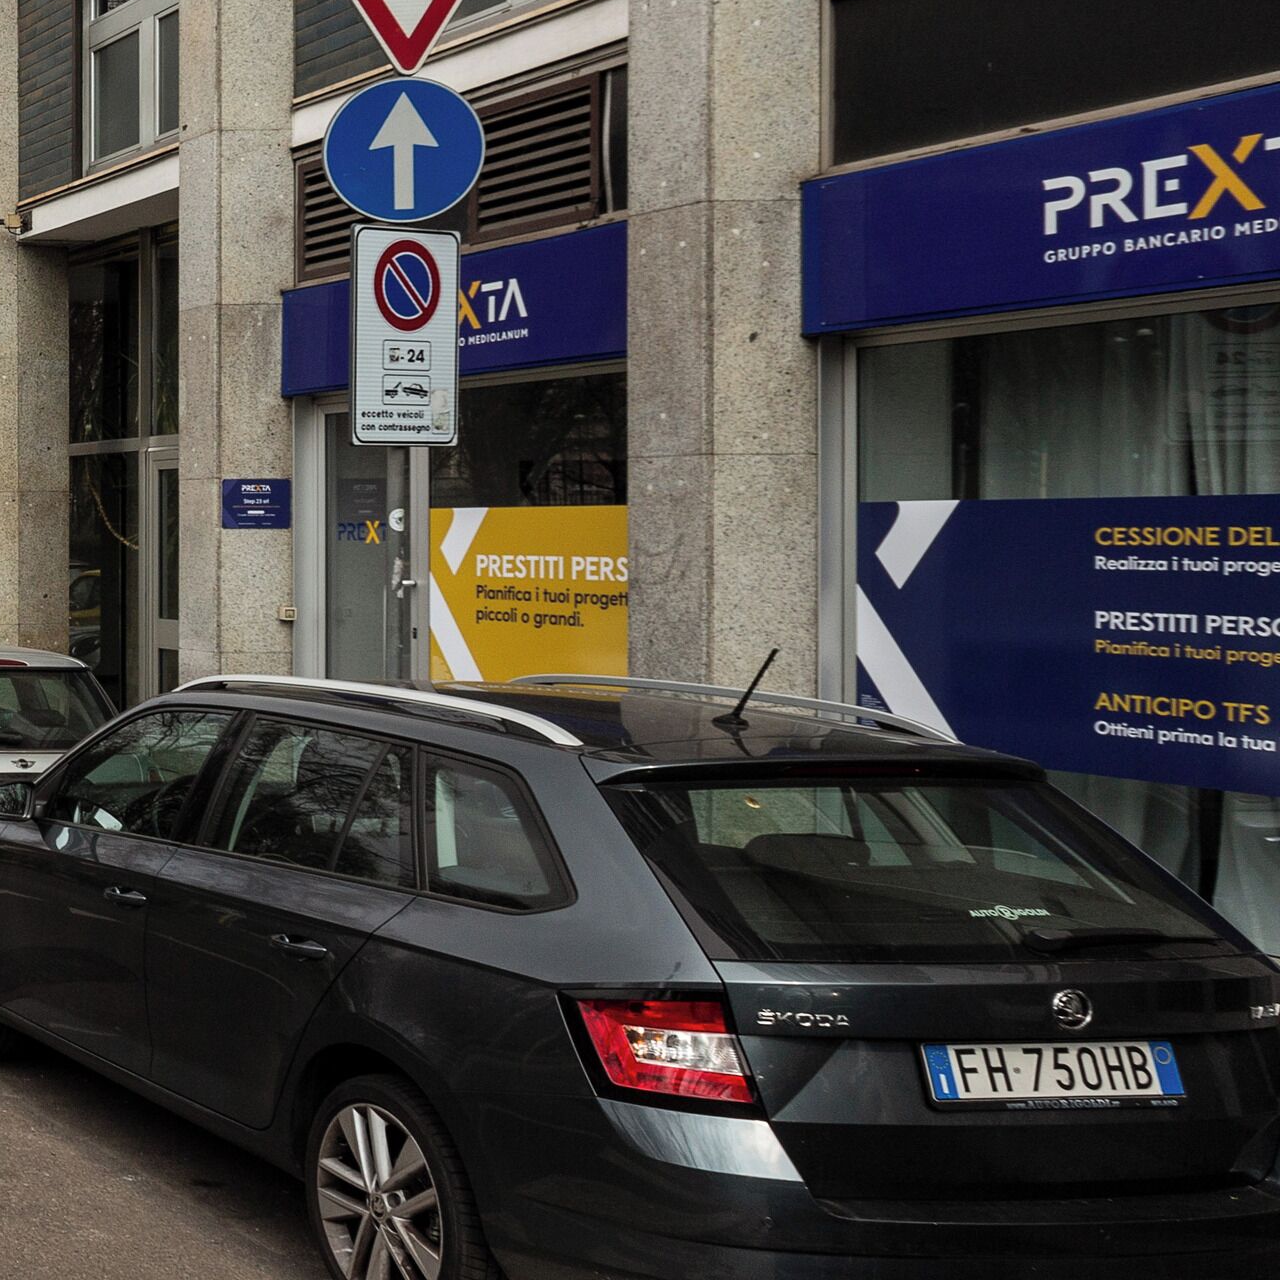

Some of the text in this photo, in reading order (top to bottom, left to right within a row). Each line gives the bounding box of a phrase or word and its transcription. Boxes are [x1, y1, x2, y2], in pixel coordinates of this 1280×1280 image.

[1042, 133, 1280, 235] PREX
[1044, 242, 1116, 263] GRUPPO
[1124, 226, 1226, 252] BANCARIO
[468, 328, 528, 345] MEDIOLANUM
[407, 349, 425, 363] 24
[361, 409, 424, 419] eccetto veicoli
[361, 423, 431, 433] con contrassegno
[1095, 527, 1280, 546] CESSIONE DEL
[476, 554, 563, 579] PRESTITI
[1094, 556, 1168, 570] Realizza
[1172, 557, 1178, 571] i
[1183, 557, 1219, 572] tuoi
[476, 585, 531, 601] Pianifica
[535, 587, 539, 602] i
[543, 588, 570, 603] tuoi
[476, 607, 584, 628] piccoli o grandi.
[1095, 611, 1198, 633] PRESTITI
[1095, 640, 1170, 657] Pianifica
[1174, 643, 1180, 658] i
[1184, 645, 1221, 661] tuoi
[1094, 692, 1271, 725] ANTICIPO TFS
[1094, 720, 1276, 751] Ottieni prima la tua
